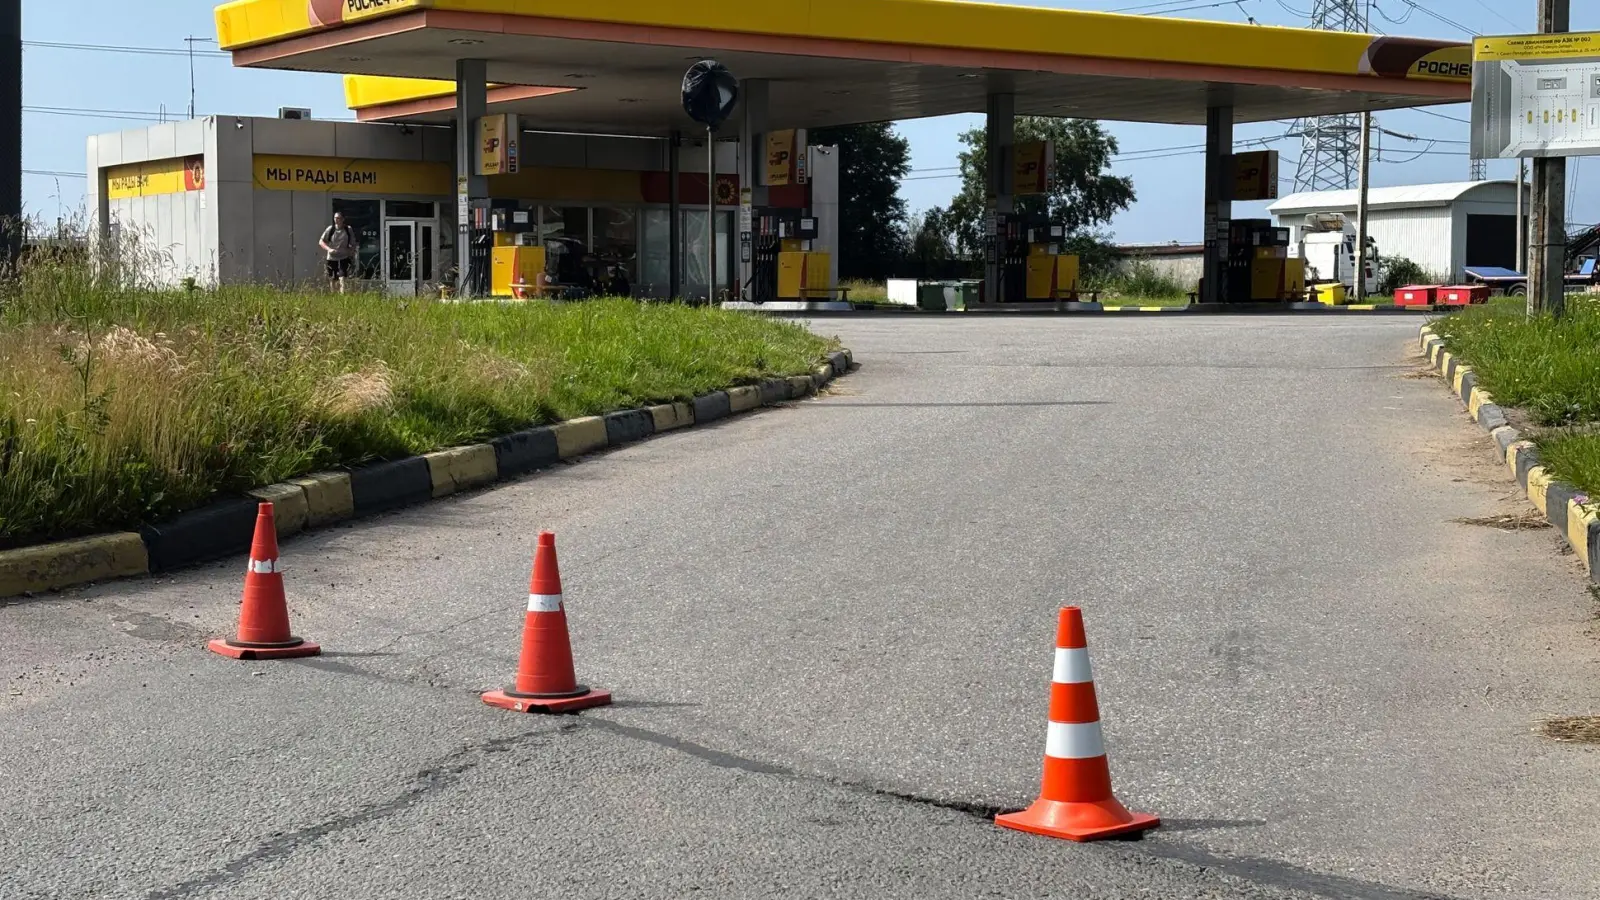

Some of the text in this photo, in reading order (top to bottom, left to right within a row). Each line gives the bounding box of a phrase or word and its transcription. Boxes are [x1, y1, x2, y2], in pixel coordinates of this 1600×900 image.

[1417, 60, 1472, 76] РОСНЕ
[266, 167, 377, 184] МЫ РАДЫ ВАМ!
